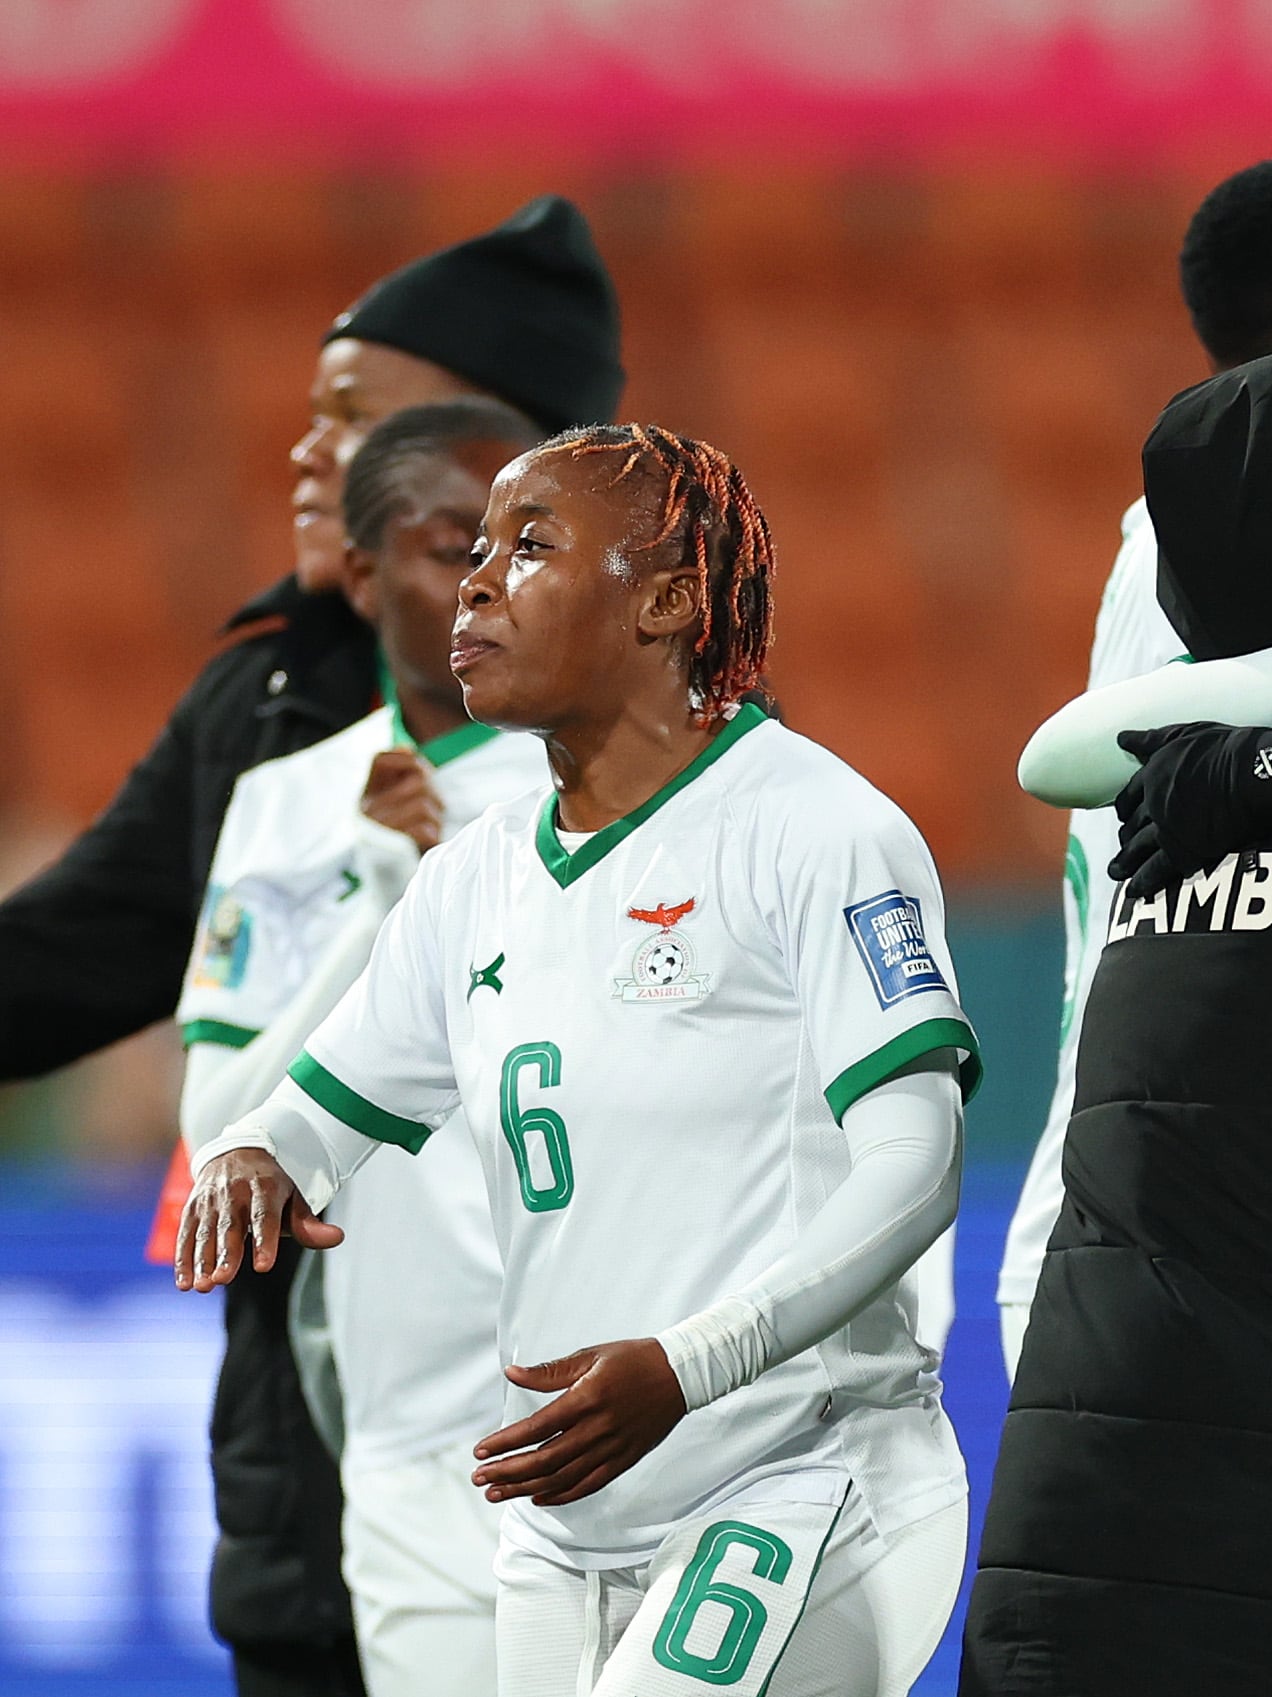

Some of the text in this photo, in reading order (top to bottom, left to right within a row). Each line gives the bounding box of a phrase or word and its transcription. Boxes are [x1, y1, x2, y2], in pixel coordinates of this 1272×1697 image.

[870, 907, 909, 932] FOOTB
[876, 921, 923, 950] UNITE
[881, 941, 929, 968] the Wor
[907, 962, 930, 973] FIFA
[636, 986, 686, 998] ZAMBIA
[501, 1041, 575, 1213] 6
[652, 1520, 794, 1686] 6
